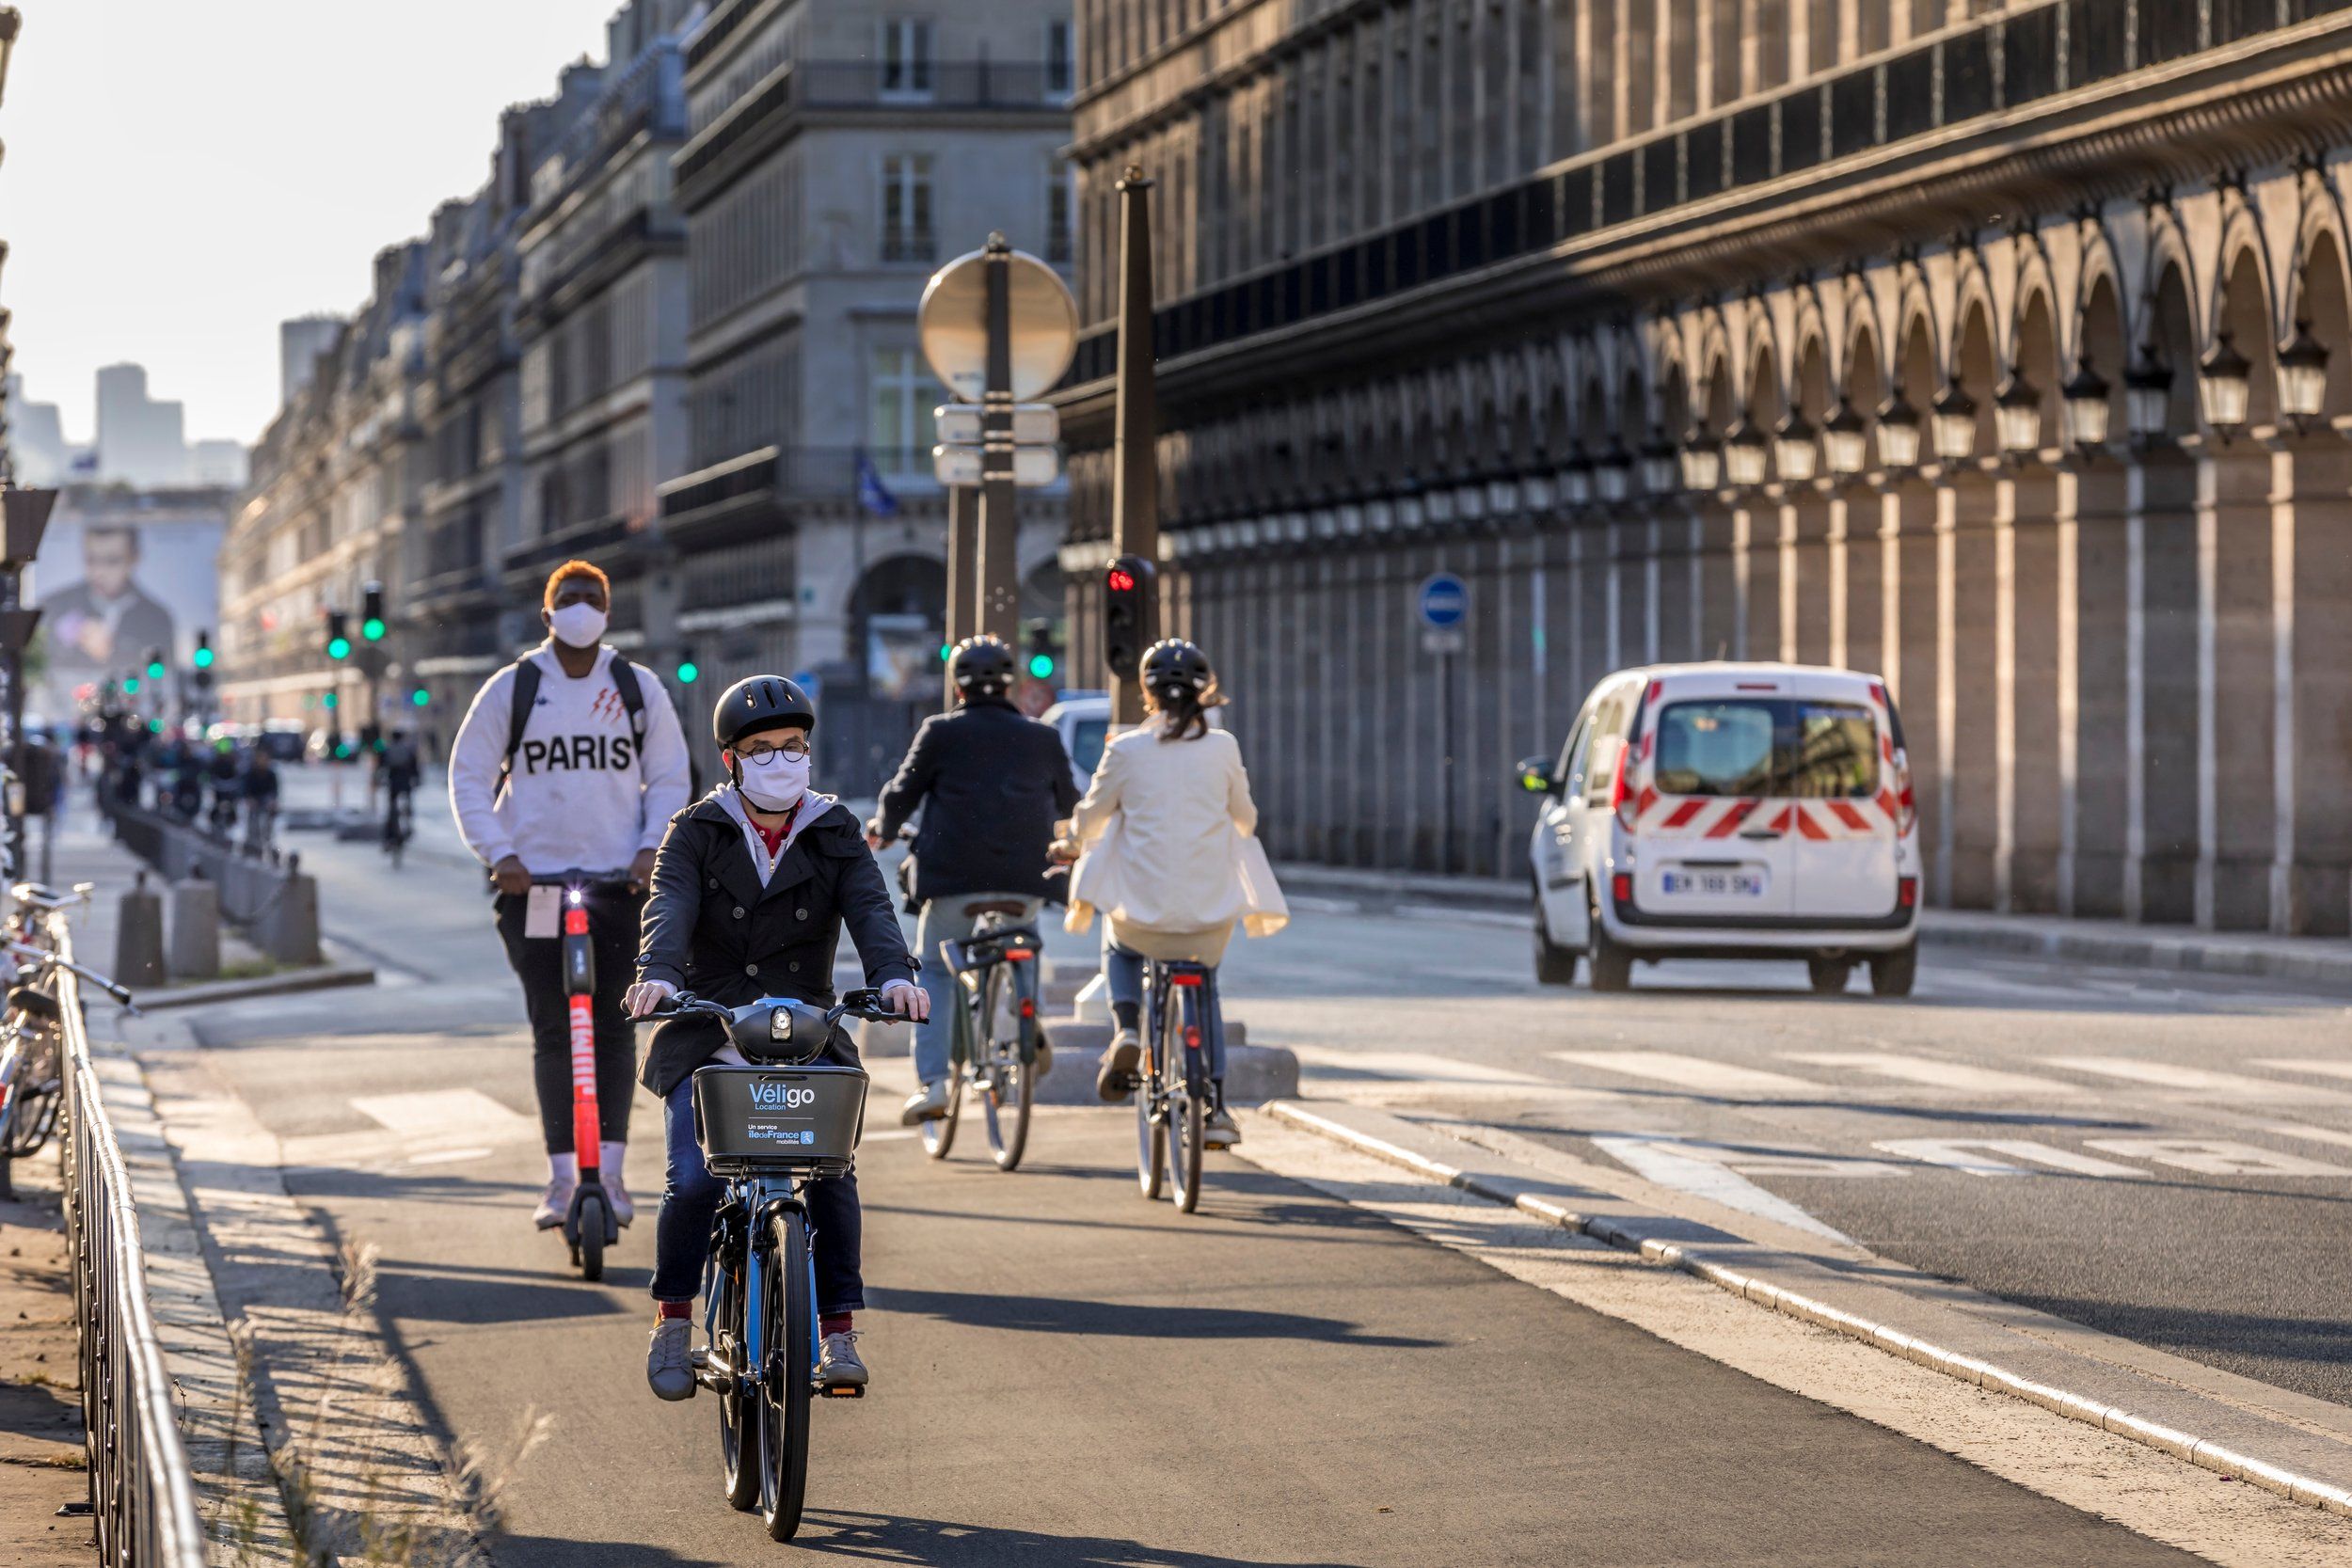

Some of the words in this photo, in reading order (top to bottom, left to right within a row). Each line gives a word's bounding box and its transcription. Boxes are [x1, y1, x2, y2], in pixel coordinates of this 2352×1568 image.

[523, 736, 631, 775] PARIS
[569, 1006, 597, 1096] JUMP
[749, 1084, 816, 1109] Véligo
